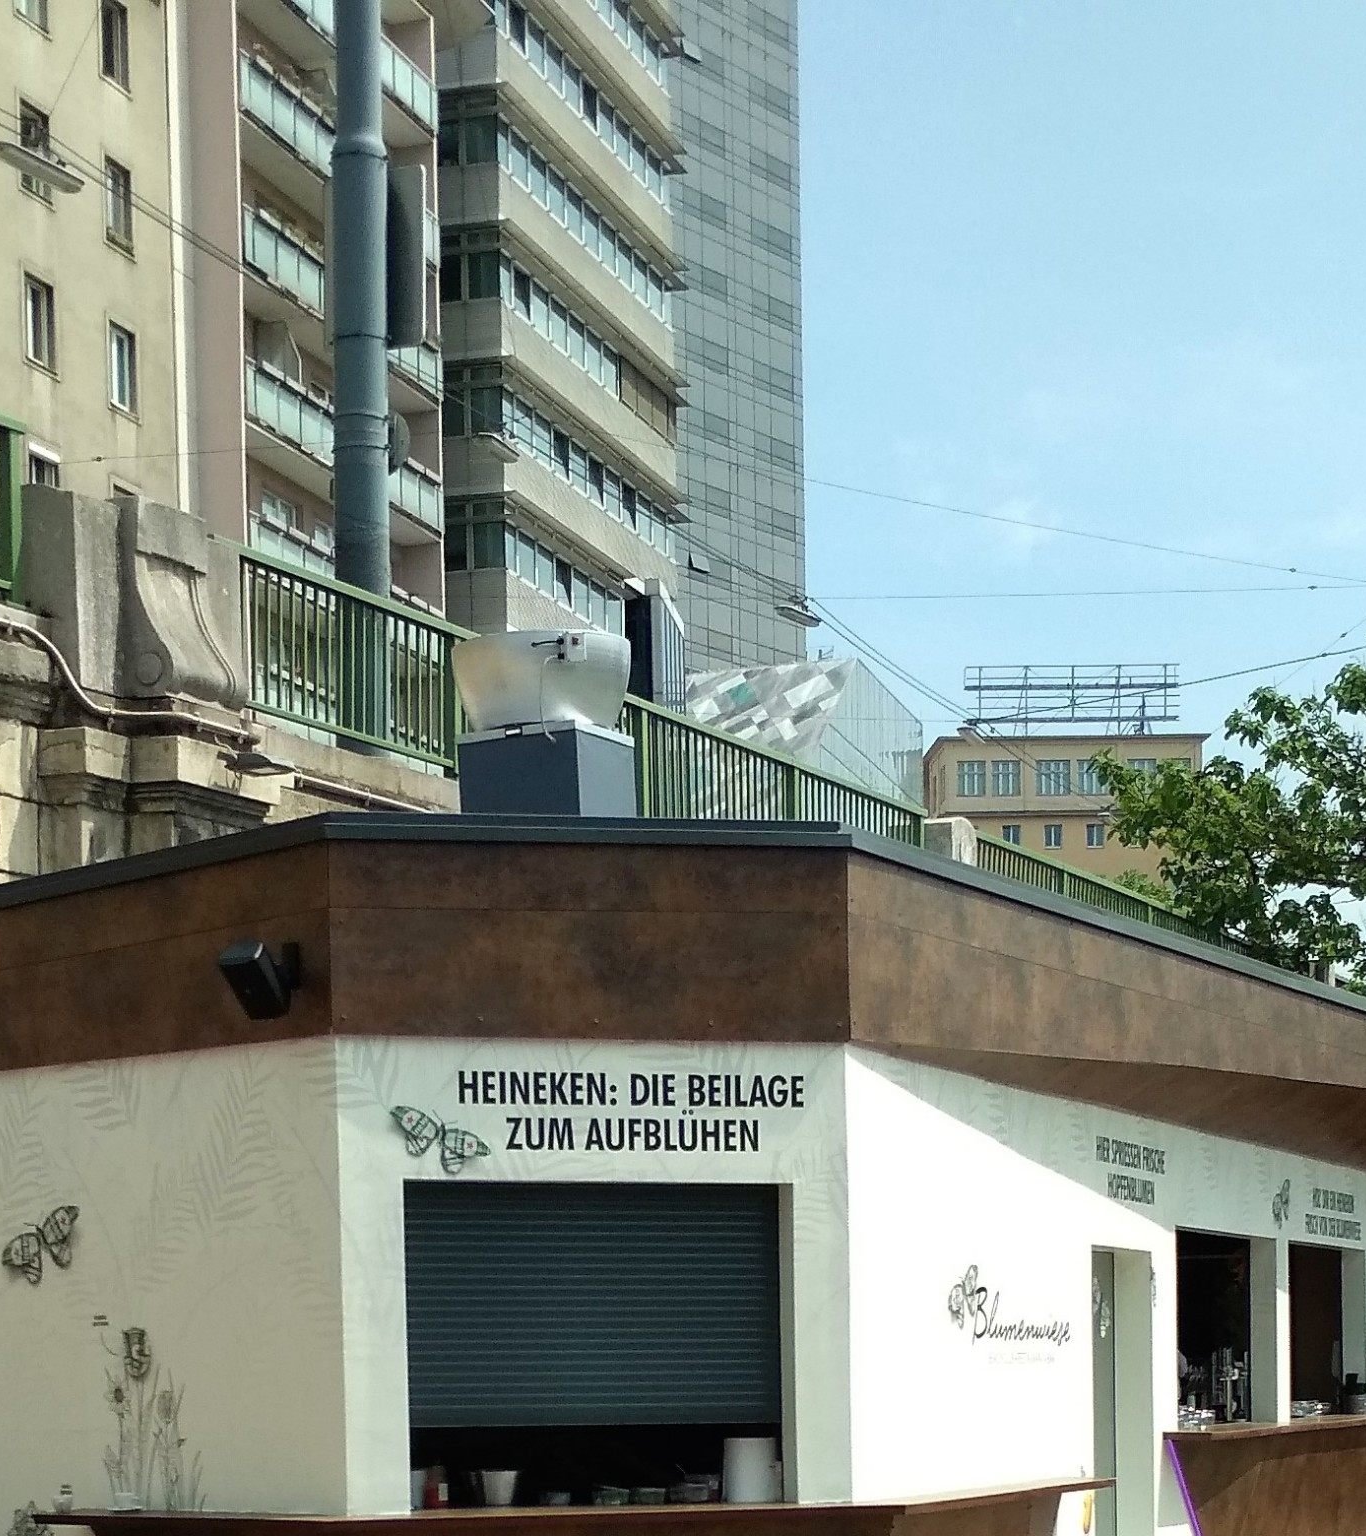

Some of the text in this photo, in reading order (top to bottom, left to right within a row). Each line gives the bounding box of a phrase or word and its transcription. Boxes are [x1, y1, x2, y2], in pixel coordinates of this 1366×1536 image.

[457, 1070, 805, 1109] HEINEKEN: DIE BEILAGE
[505, 1109, 761, 1153] ZUM AUFBLÜHEN
